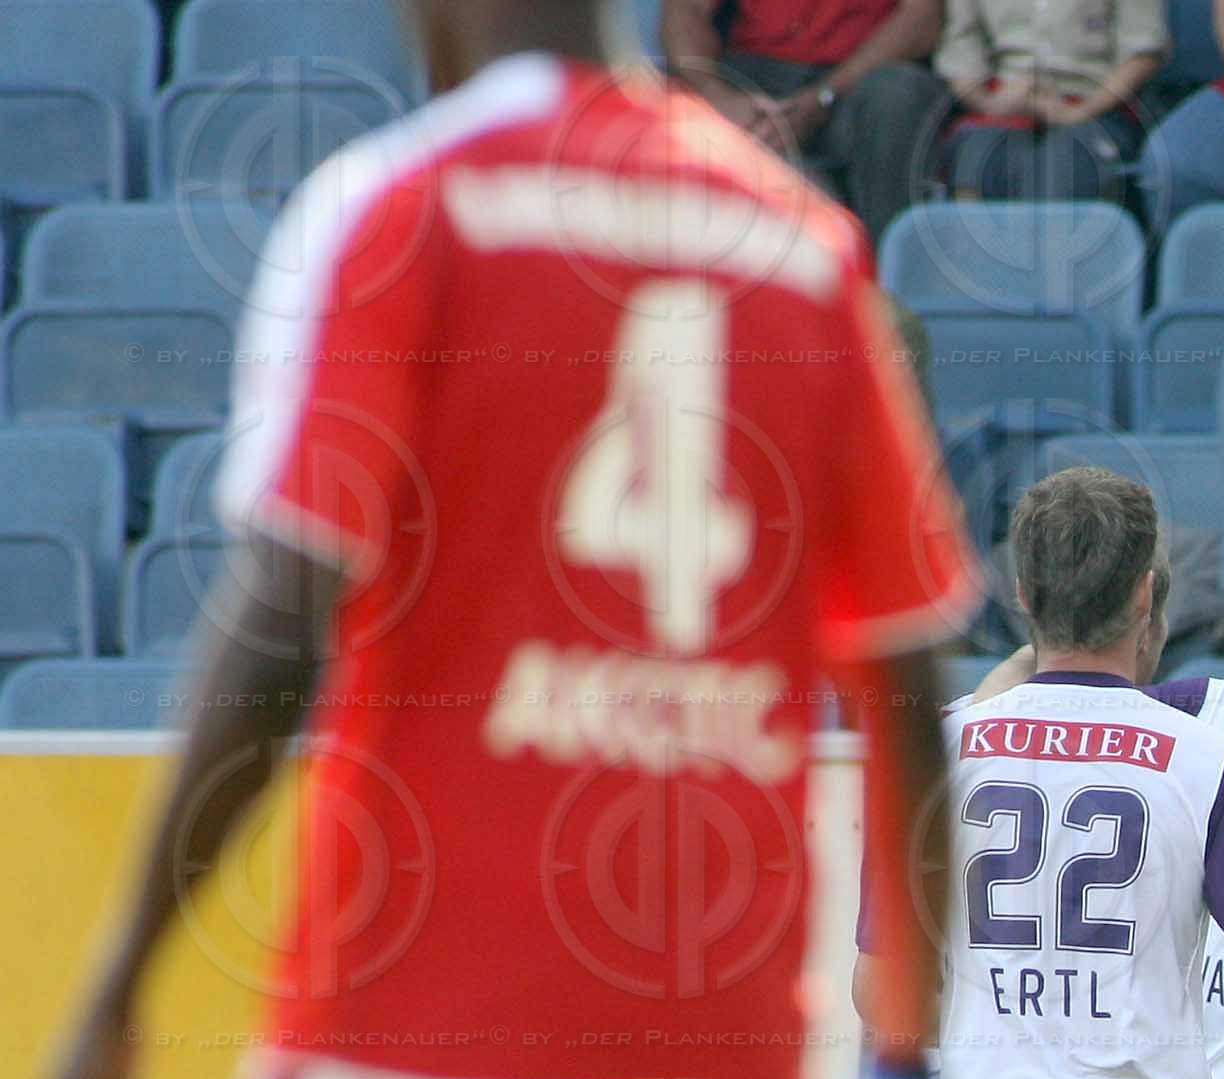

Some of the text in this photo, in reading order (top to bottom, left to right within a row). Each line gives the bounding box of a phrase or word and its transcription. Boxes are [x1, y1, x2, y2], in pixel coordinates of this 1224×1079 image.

[560, 278, 755, 650] 4
[967, 722, 1159, 765] KURIER
[962, 780, 1150, 956] 22
[990, 967, 1112, 1018] ERTL
